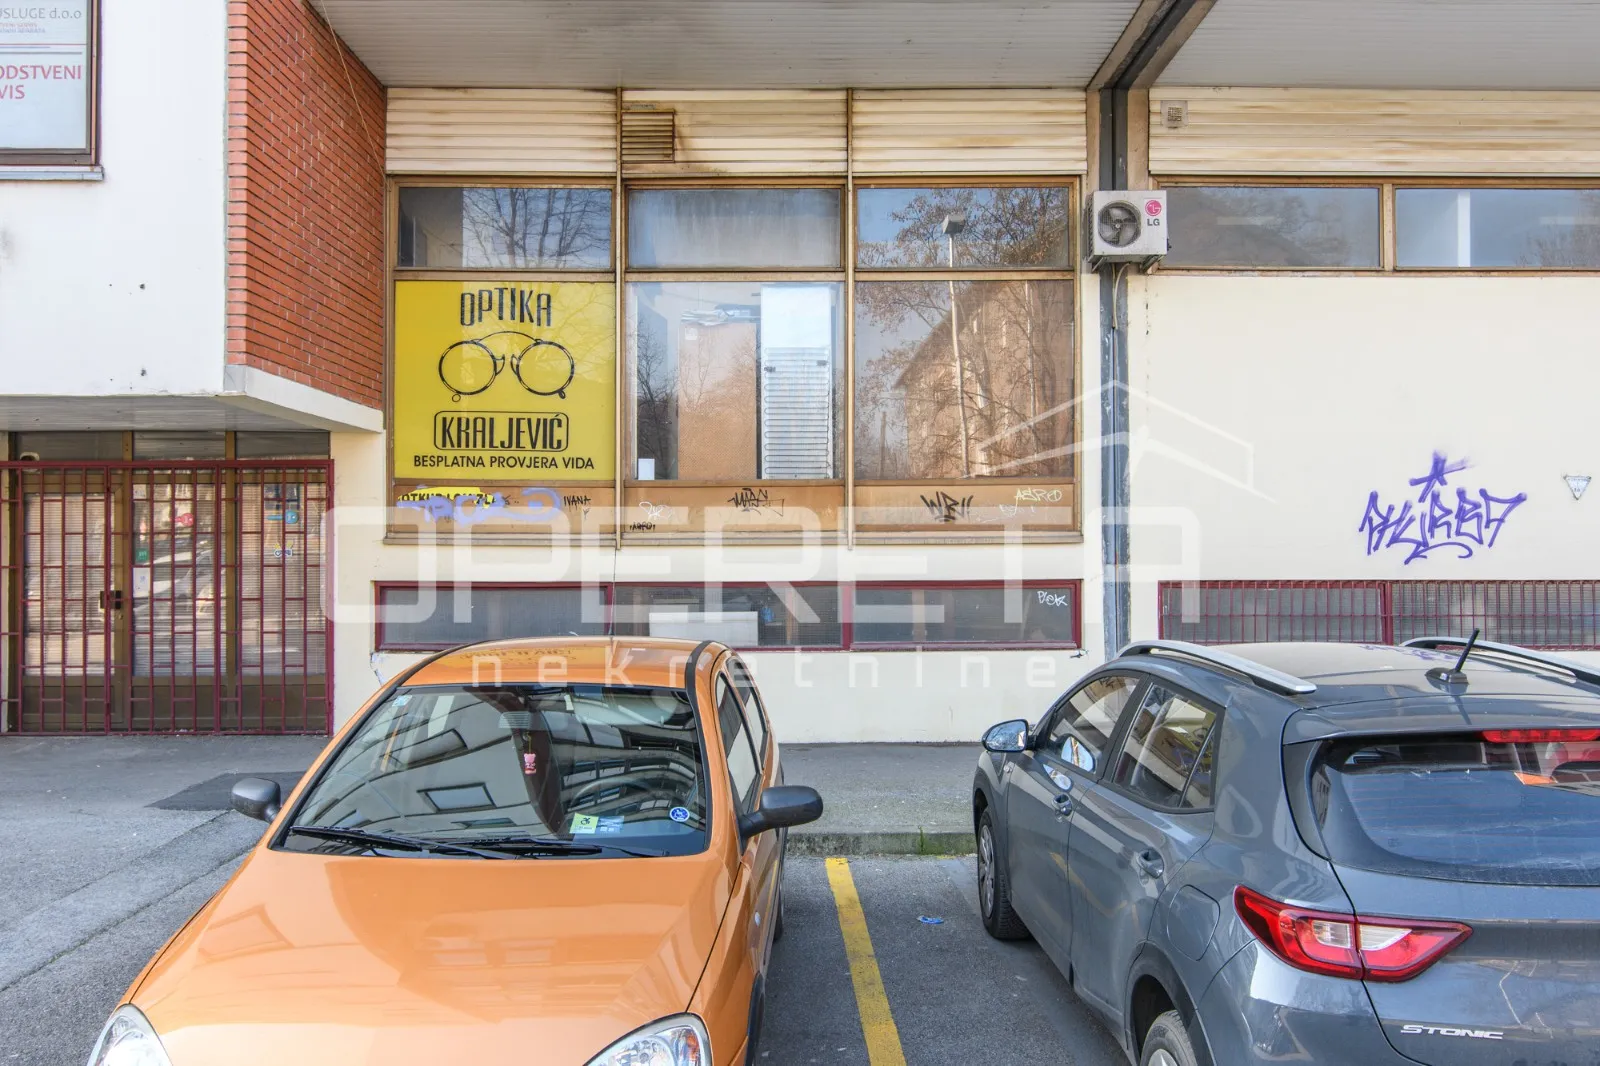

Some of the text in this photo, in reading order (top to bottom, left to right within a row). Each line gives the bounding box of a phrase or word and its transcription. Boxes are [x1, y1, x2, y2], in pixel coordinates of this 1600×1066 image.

[1147, 218, 1160, 226] LG
[460, 287, 552, 327] OPTIKA
[441, 413, 563, 450] KRALJEVIĆ
[413, 455, 595, 469] BESPLATNA PROVJERA VIDA
[563, 495, 592, 507] IVANA
[1400, 1024, 1504, 1040] STONIC
